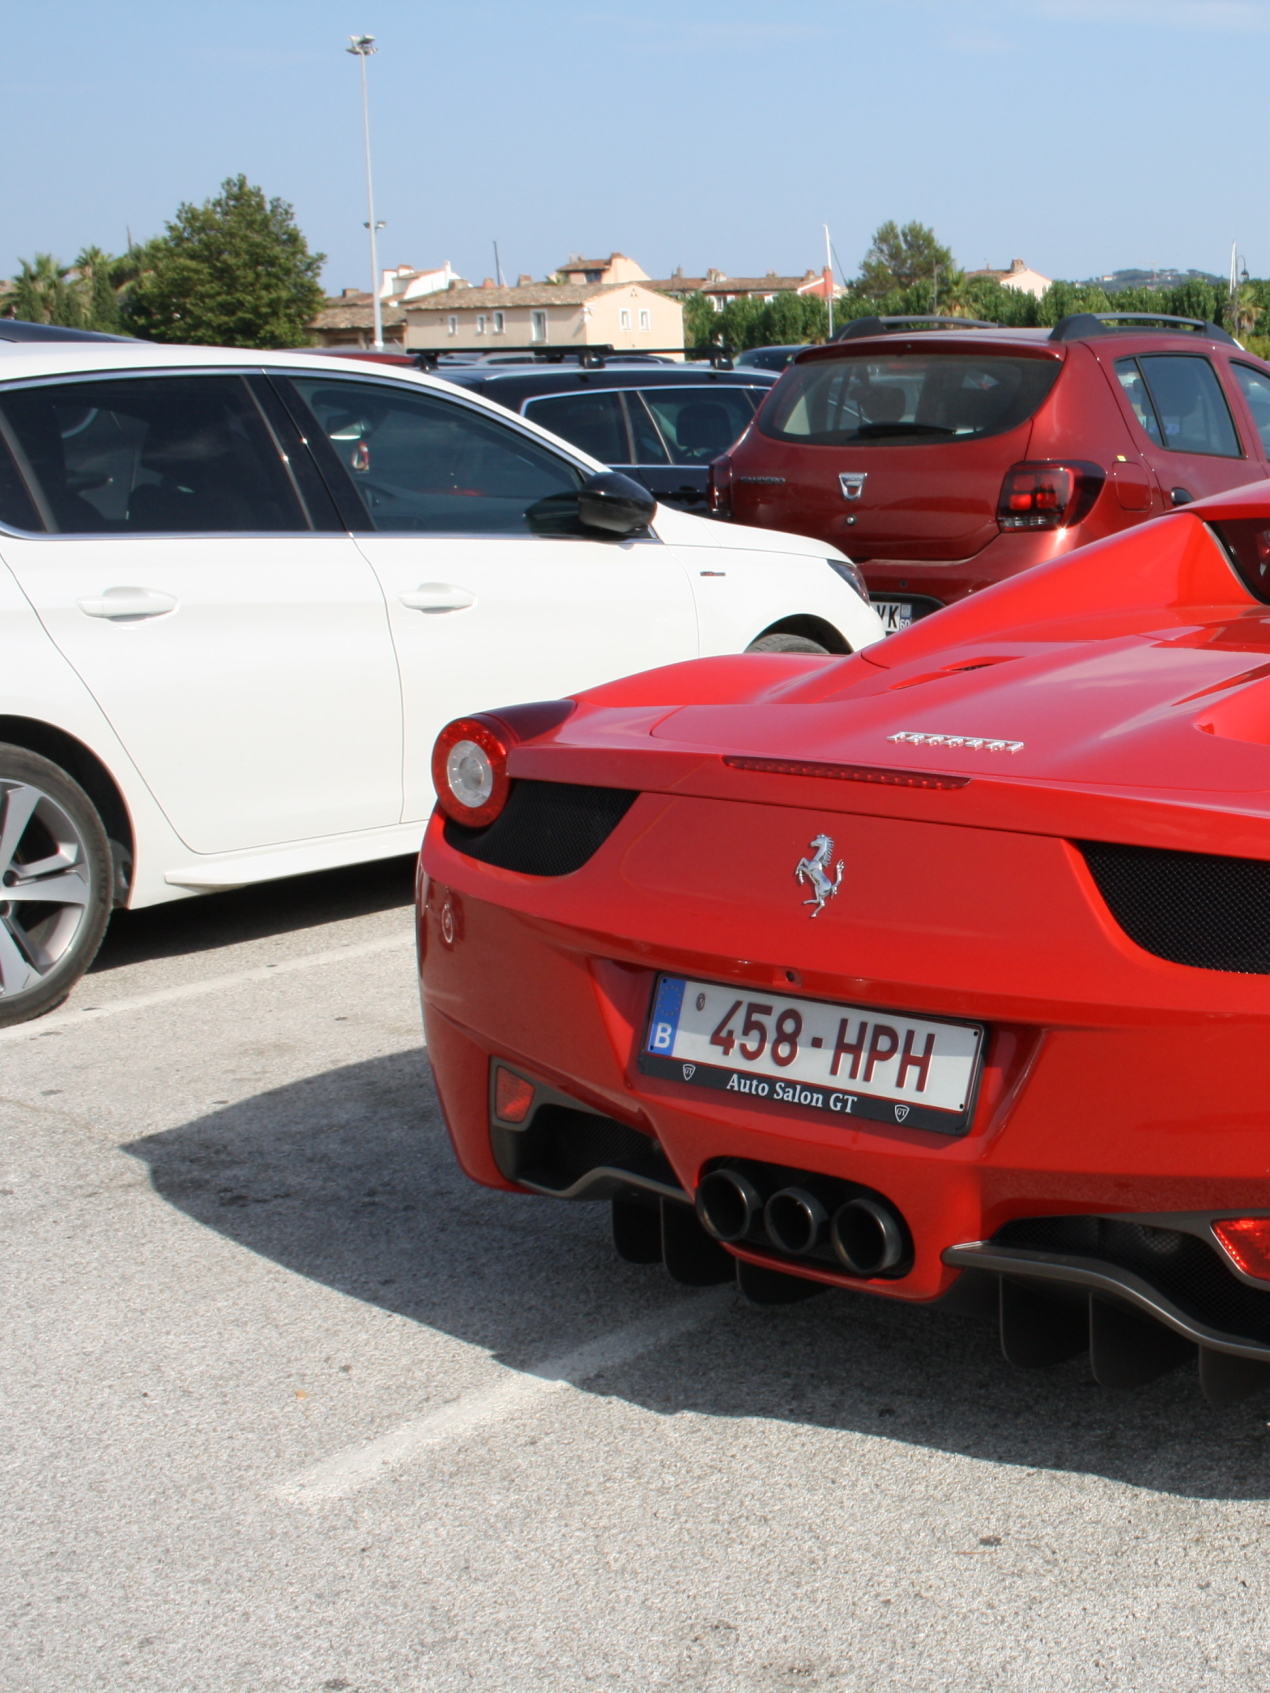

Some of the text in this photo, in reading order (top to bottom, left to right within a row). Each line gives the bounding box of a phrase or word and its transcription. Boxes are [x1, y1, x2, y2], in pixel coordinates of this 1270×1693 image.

[886, 731, 1025, 752] FERRARI
[654, 1022, 672, 1048] B
[709, 1000, 936, 1093] 458-HPH
[726, 1073, 857, 1113] Auto Salon GT
